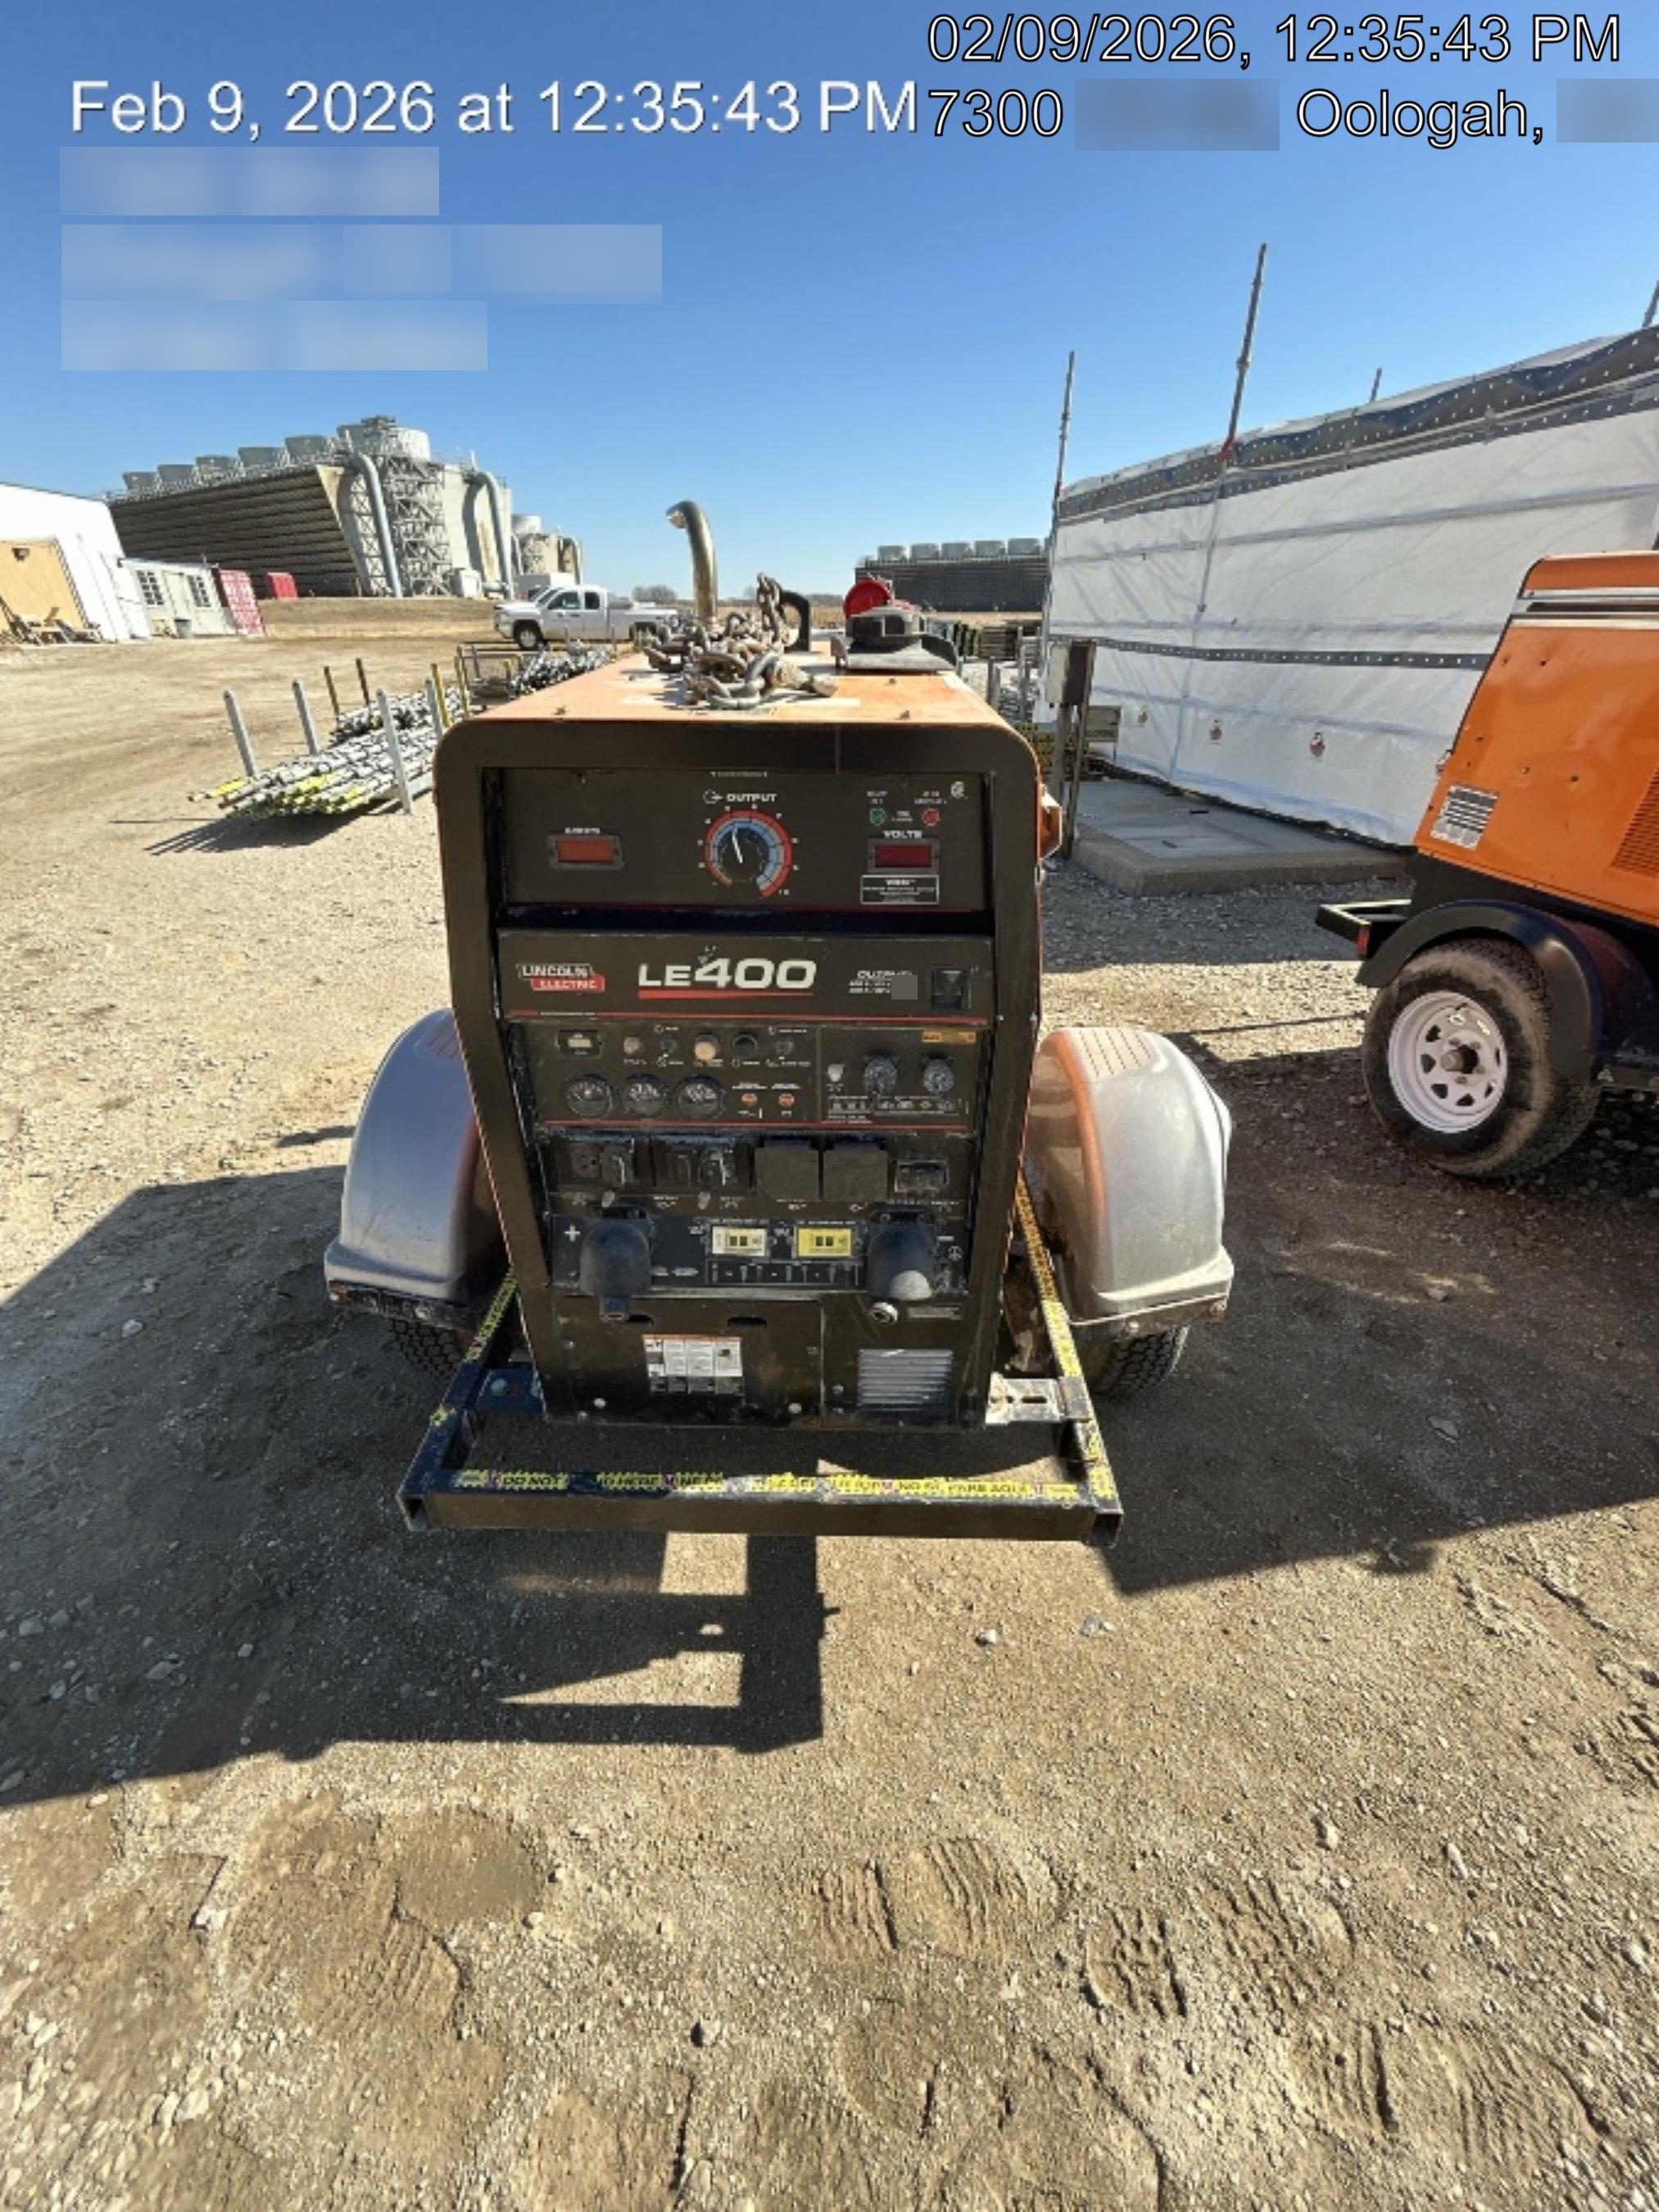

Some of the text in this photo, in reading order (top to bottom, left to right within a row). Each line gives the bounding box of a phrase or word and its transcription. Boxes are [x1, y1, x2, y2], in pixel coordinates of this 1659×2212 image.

[726, 792, 777, 803] OUTPUT
[882, 830, 922, 840] VOLTS
[522, 964, 588, 978] LINCOLN
[637, 957, 818, 990] LE400
[539, 979, 598, 990] ELECTRIC
